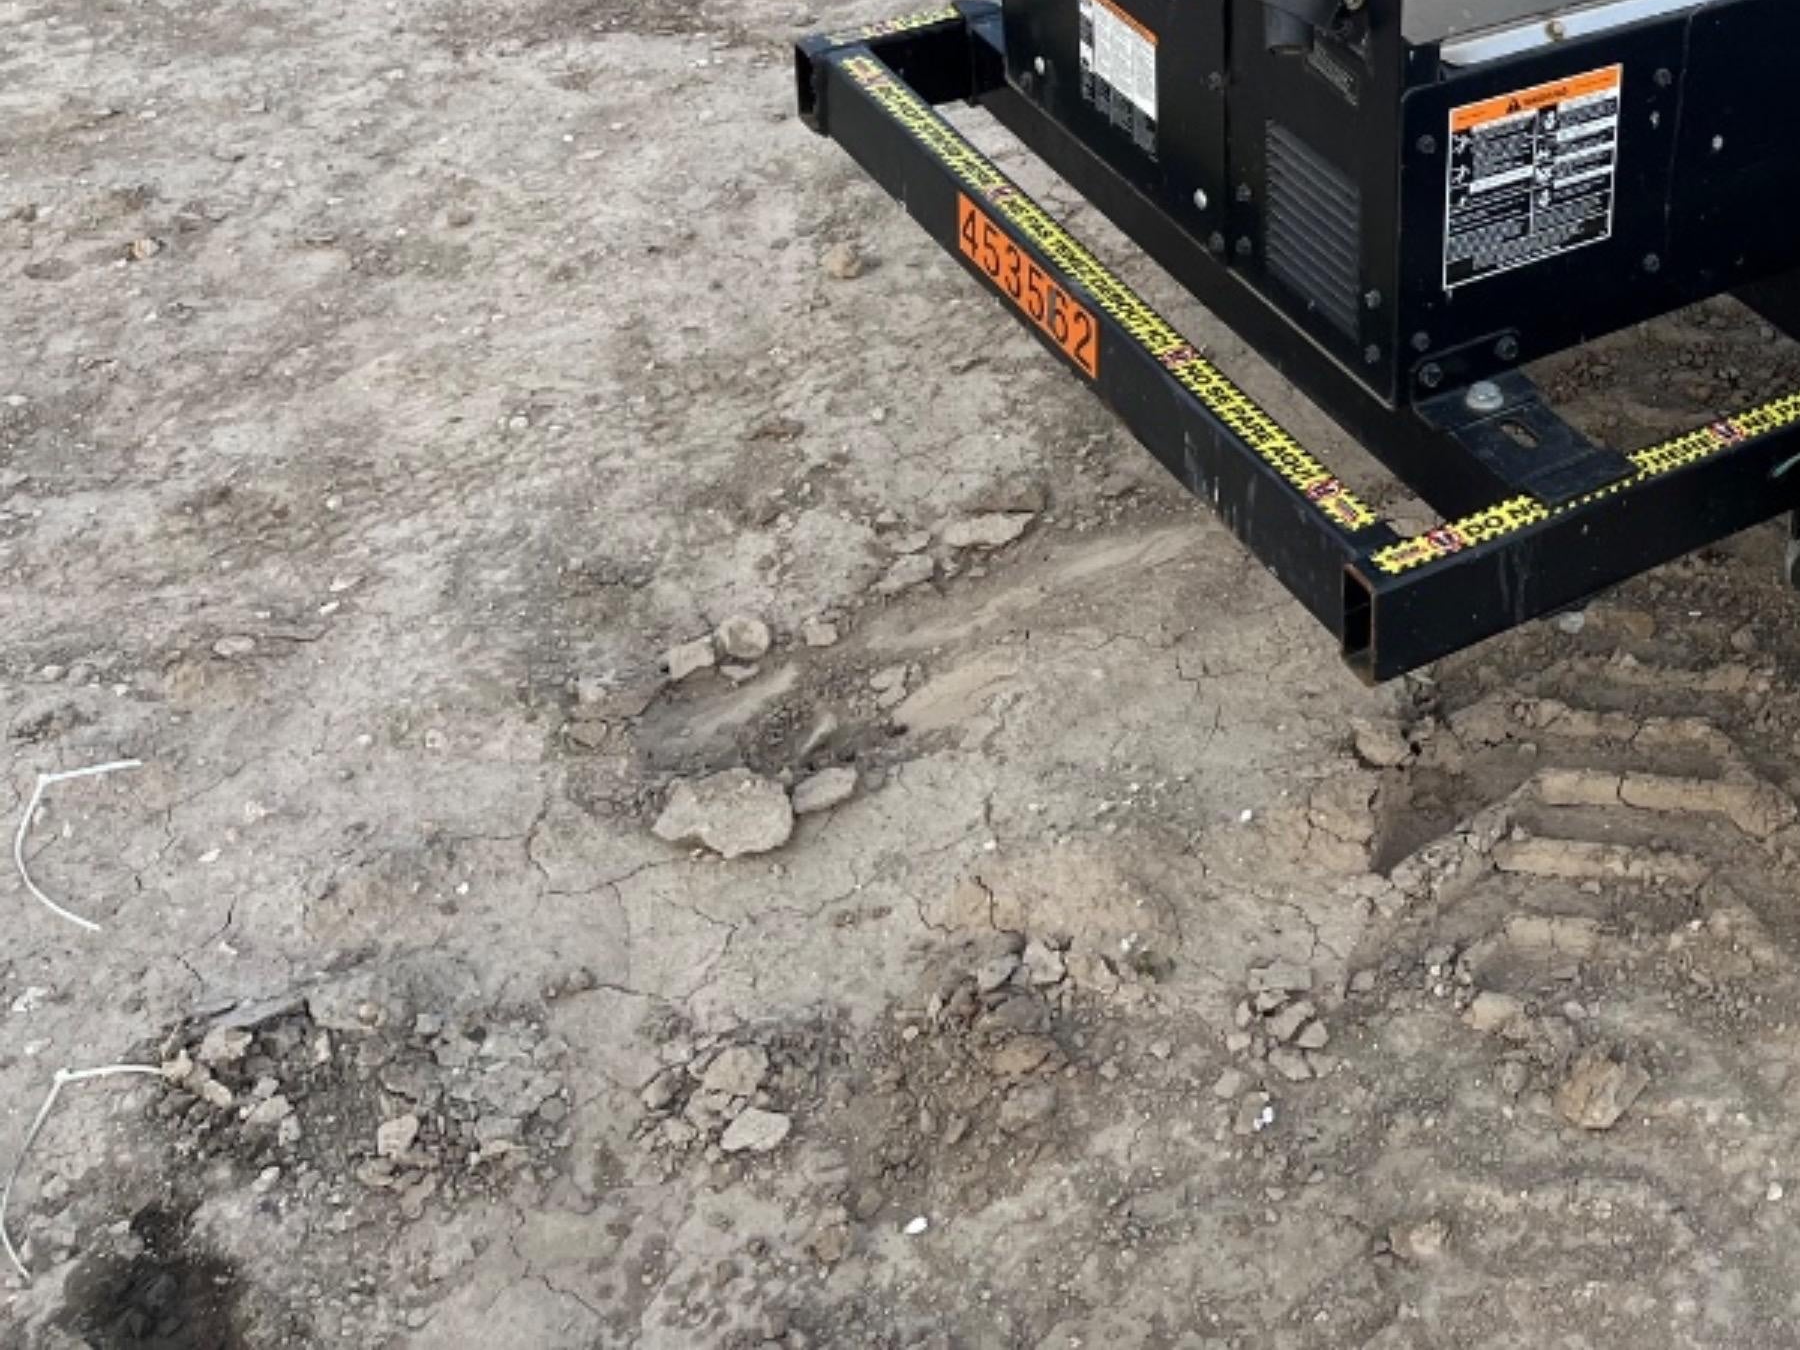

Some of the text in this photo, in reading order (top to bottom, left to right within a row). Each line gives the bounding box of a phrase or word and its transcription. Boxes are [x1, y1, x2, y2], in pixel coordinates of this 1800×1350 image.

[962, 209, 1093, 372] 453562
[1180, 362, 1214, 386] NO
[1204, 384, 1235, 405] SE
[1226, 403, 1277, 443] PARE
[1466, 516, 1503, 534] DO
